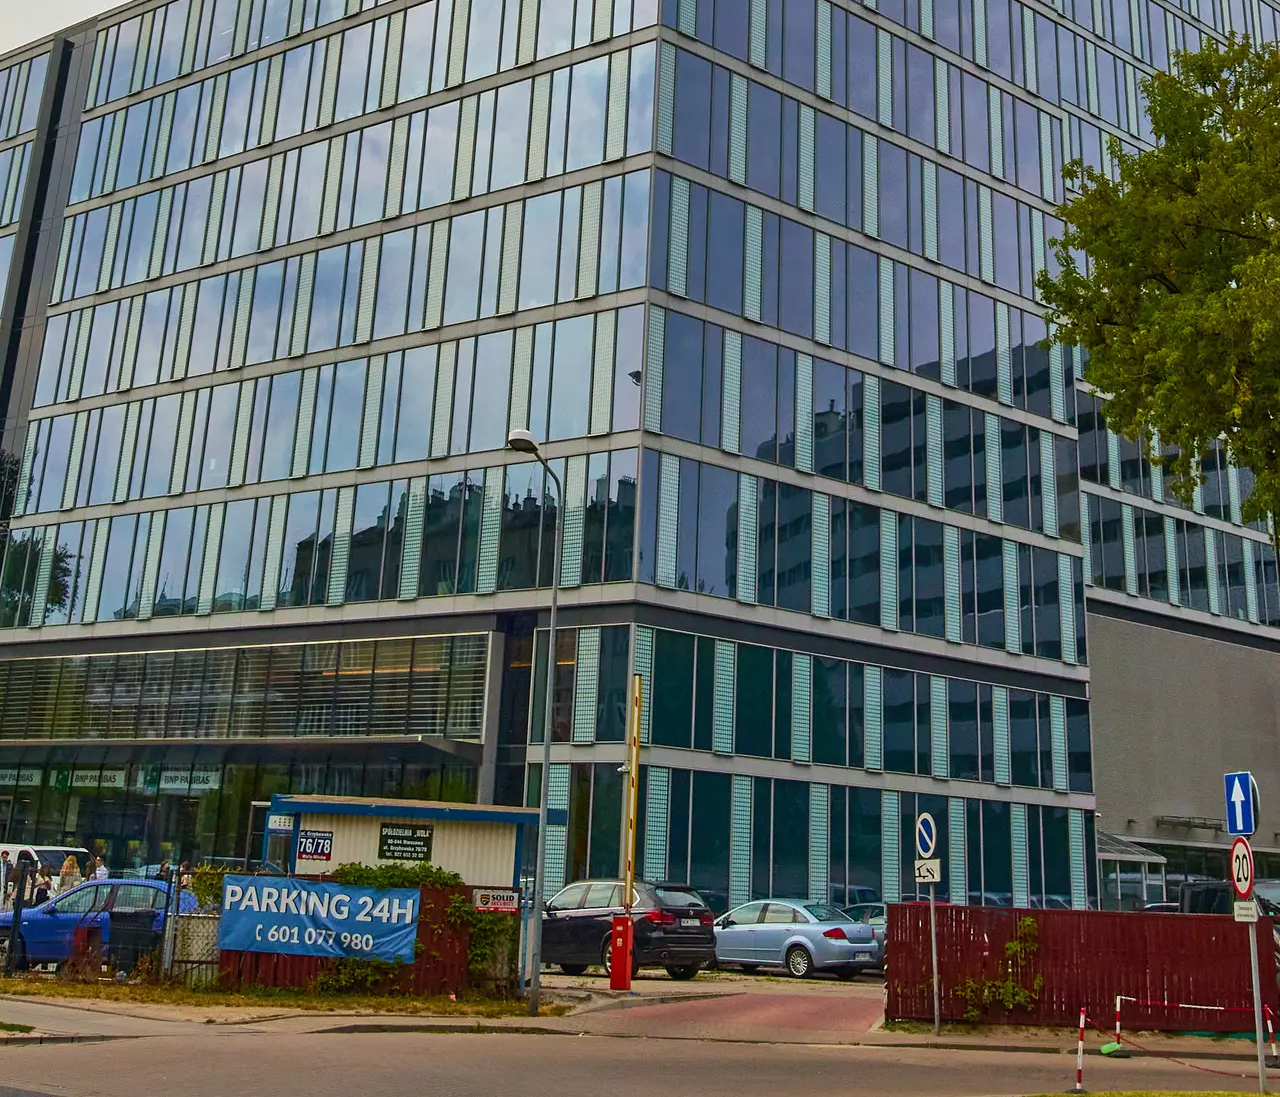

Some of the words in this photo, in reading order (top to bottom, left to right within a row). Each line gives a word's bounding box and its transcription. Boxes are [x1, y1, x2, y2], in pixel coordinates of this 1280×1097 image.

[75, 774, 88, 782] BNP
[164, 775, 179, 784] BNP
[300, 838, 331, 853] 76/78
[1235, 853, 1249, 883] 20
[224, 885, 351, 920] PARKING
[355, 896, 415, 924] 24H
[491, 894, 515, 902] SOLID
[267, 924, 300, 944] 601
[304, 928, 337, 946] 077
[340, 932, 374, 951] 980
